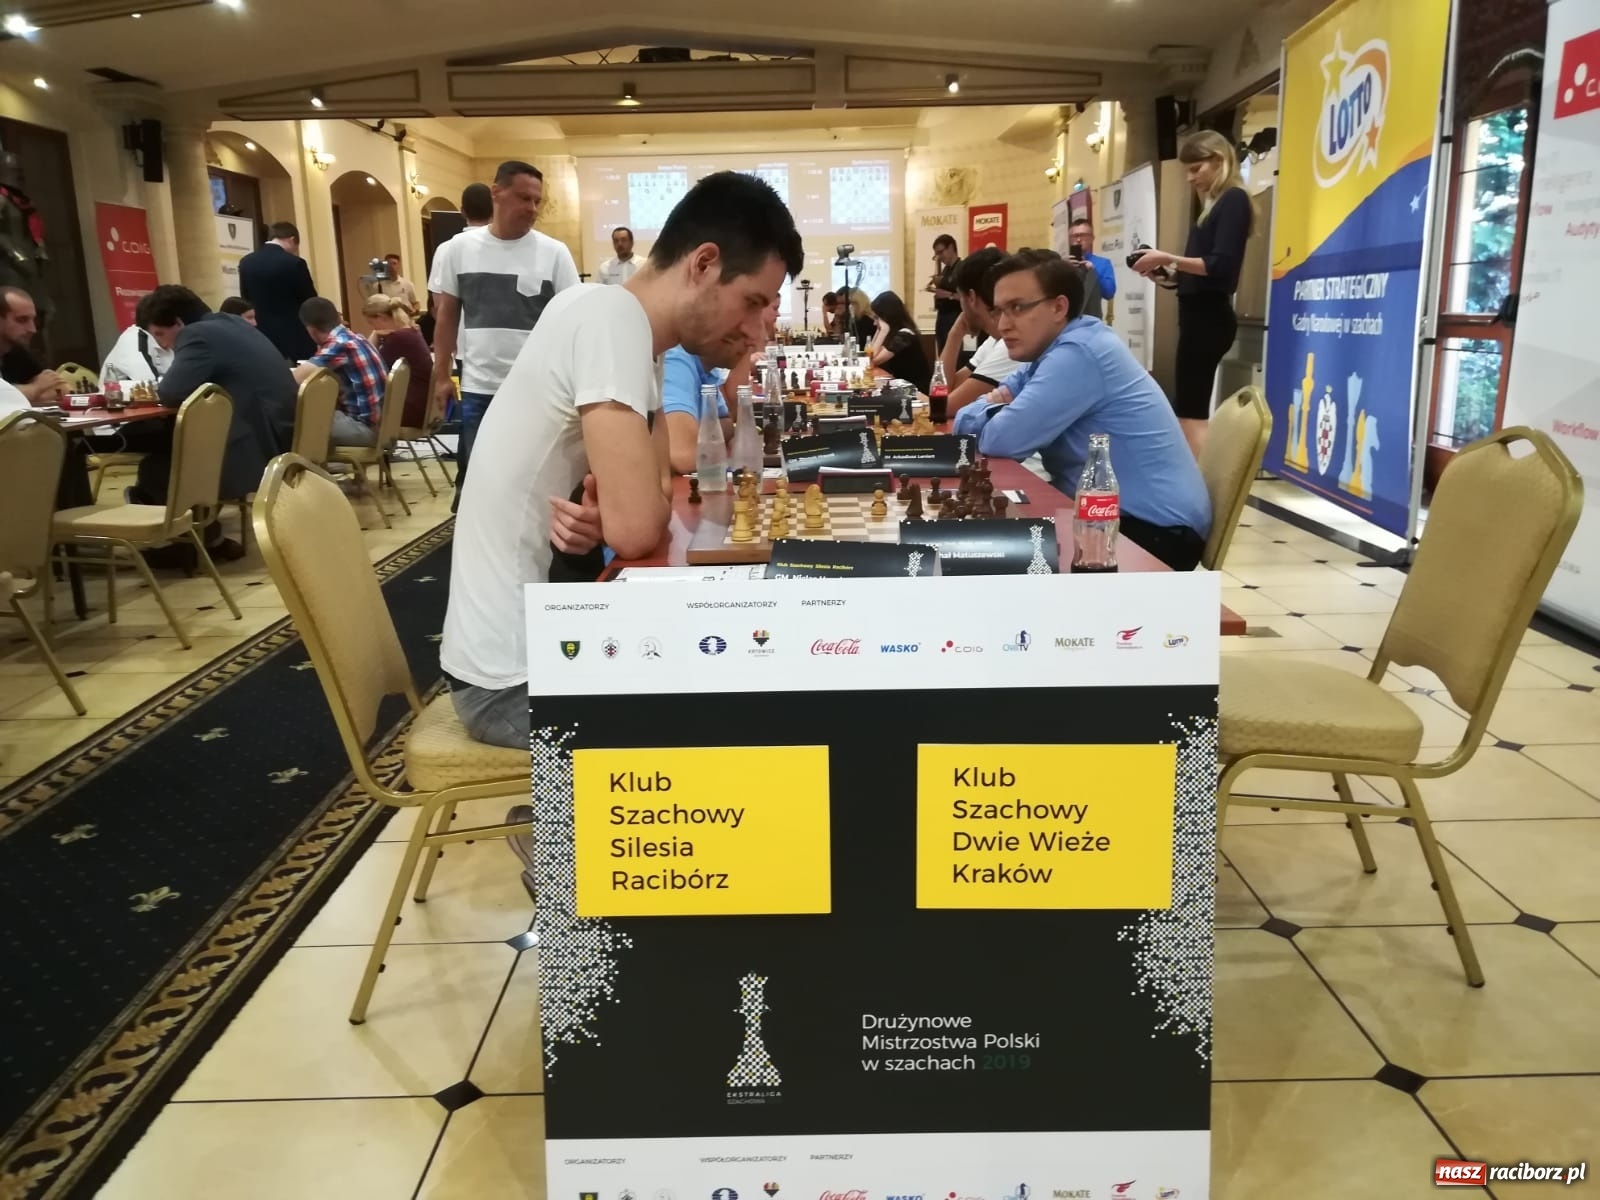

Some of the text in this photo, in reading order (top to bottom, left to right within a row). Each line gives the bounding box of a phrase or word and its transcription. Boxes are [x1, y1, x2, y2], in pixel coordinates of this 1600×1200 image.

[1329, 72, 1371, 155] LOTTO
[921, 215, 958, 226] MOKATE
[544, 603, 610, 611] ORGANIZATORZY
[880, 644, 919, 653] WASKO
[1054, 637, 1095, 647] MOKATE
[610, 771, 672, 792] Klub
[954, 767, 1016, 787] Klub
[610, 804, 745, 828] Szachowy
[952, 799, 1088, 824] Szachowy
[610, 836, 694, 858] Silesia
[953, 831, 1111, 851] Dwie Wieże
[612, 868, 729, 891] Racibórz
[953, 863, 1053, 884] Kraków
[862, 1013, 972, 1032] Drużynowe
[862, 1033, 1040, 1050] Mistrzostwa Polski
[861, 1054, 1031, 1071] w szachach 2019
